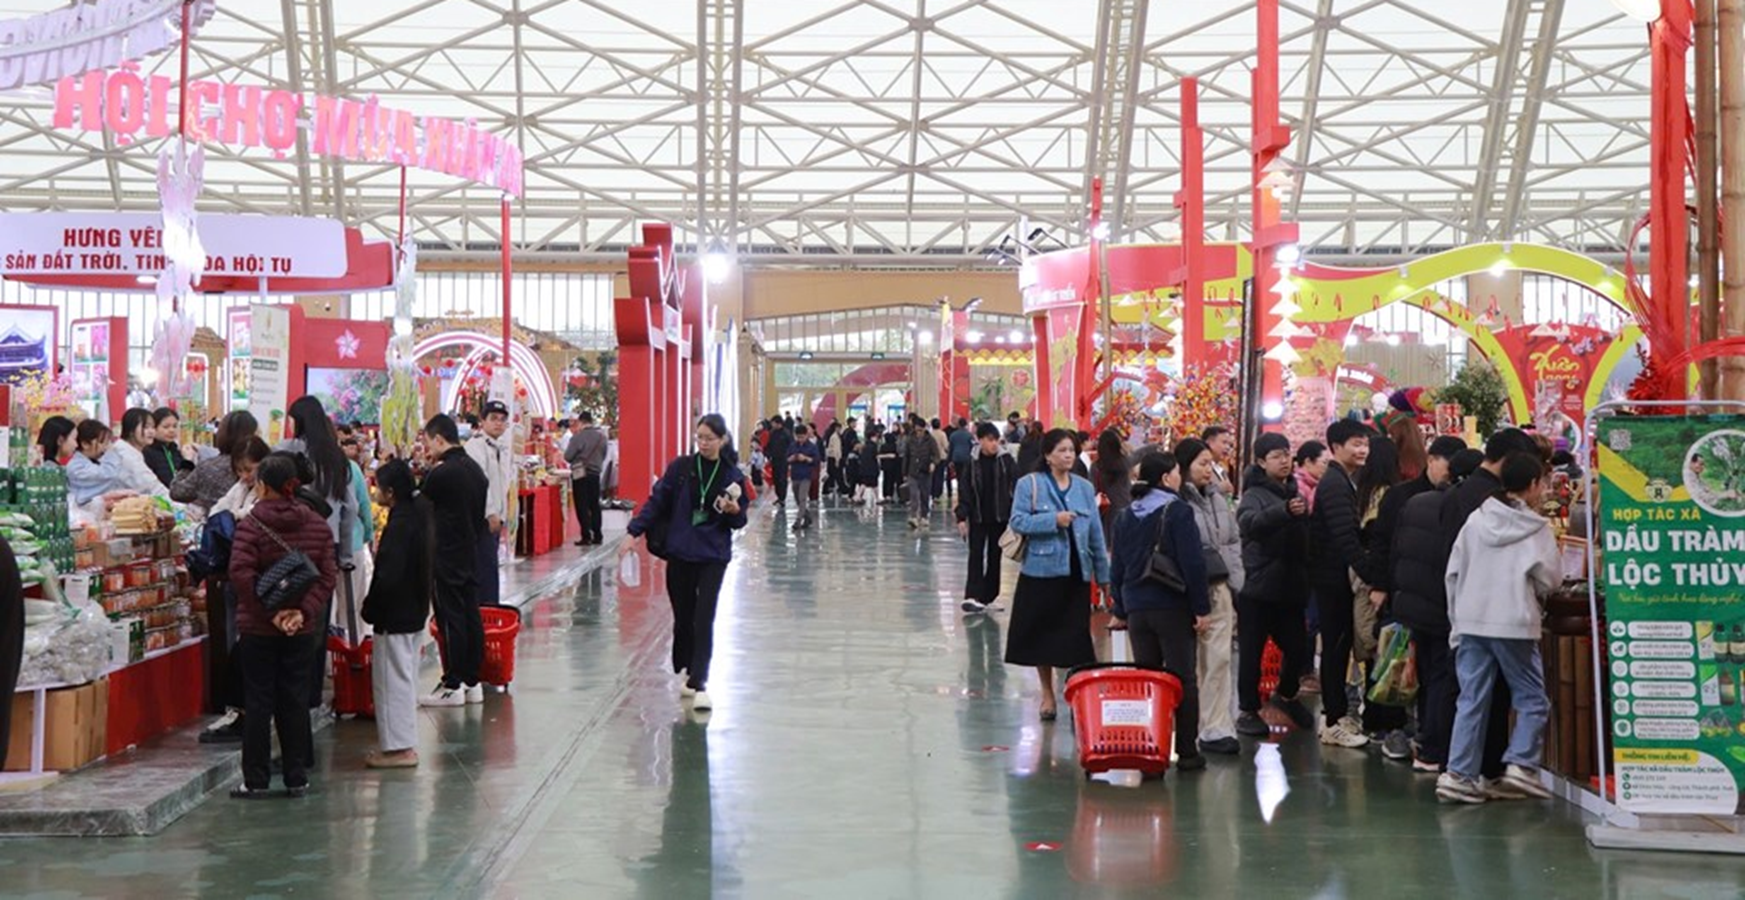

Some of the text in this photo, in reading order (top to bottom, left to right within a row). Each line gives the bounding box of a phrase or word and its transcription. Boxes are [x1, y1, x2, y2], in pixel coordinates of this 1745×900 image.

[53, 61, 171, 146] HỘI
[187, 80, 304, 160] CHỢ
[64, 227, 121, 248] HƯNG
[5, 250, 36, 269] SẢN
[43, 248, 73, 269] ĐẤT
[271, 258, 291, 275] TỤ
[1613, 507, 1701, 522] HỢP TÁC XÃ
[1606, 523, 1745, 551] DẦU TRÀM
[1608, 558, 1745, 590] LỘC THỦY
